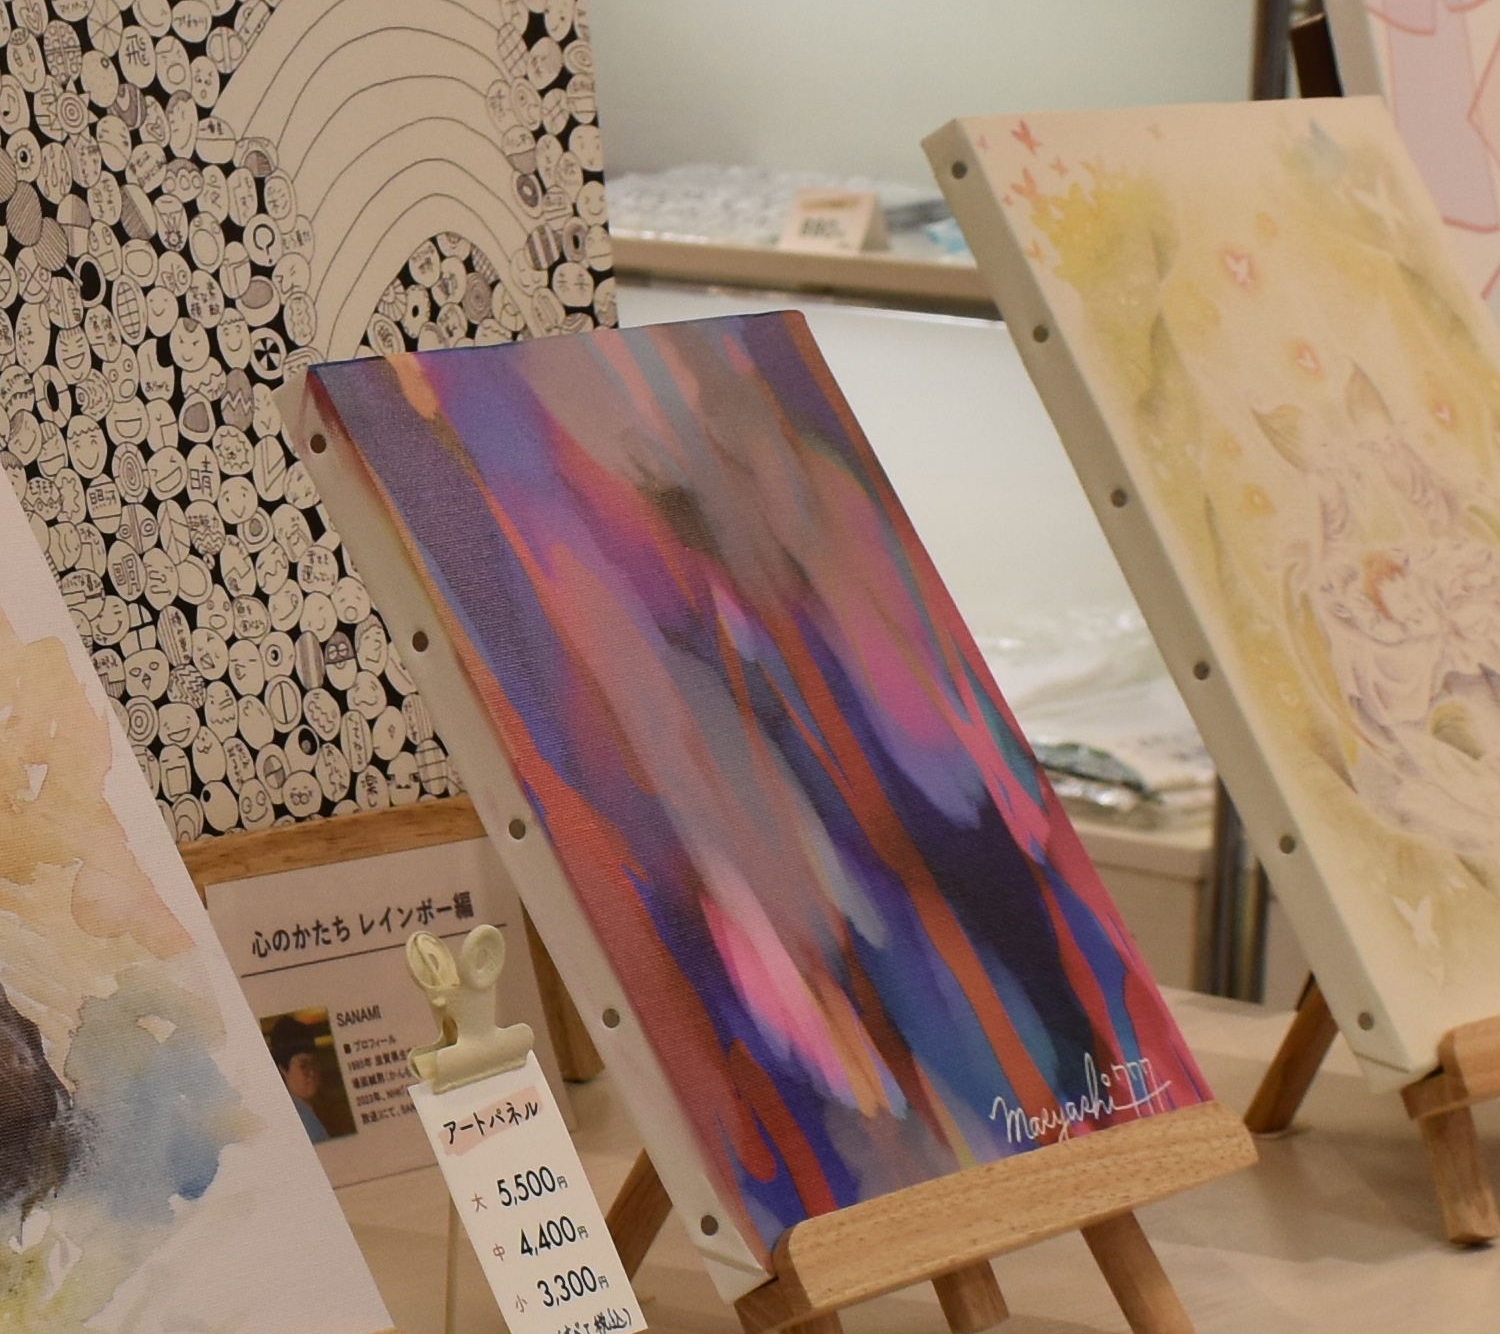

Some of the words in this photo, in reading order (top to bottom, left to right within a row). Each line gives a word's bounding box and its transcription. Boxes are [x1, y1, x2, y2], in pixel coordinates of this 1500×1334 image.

[251, 913, 353, 960] 心のかたち
[358, 890, 475, 938] レインボー編
[336, 1004, 382, 1028] SANAMI
[442, 1099, 540, 1145] アートパネル
[471, 1192, 488, 1212] 大
[497, 1165, 568, 1208] 5,500円
[493, 1242, 507, 1262] 中
[519, 1215, 589, 1259] 4,400円
[514, 1293, 528, 1313] 小
[536, 1266, 609, 1309] 3,300円
